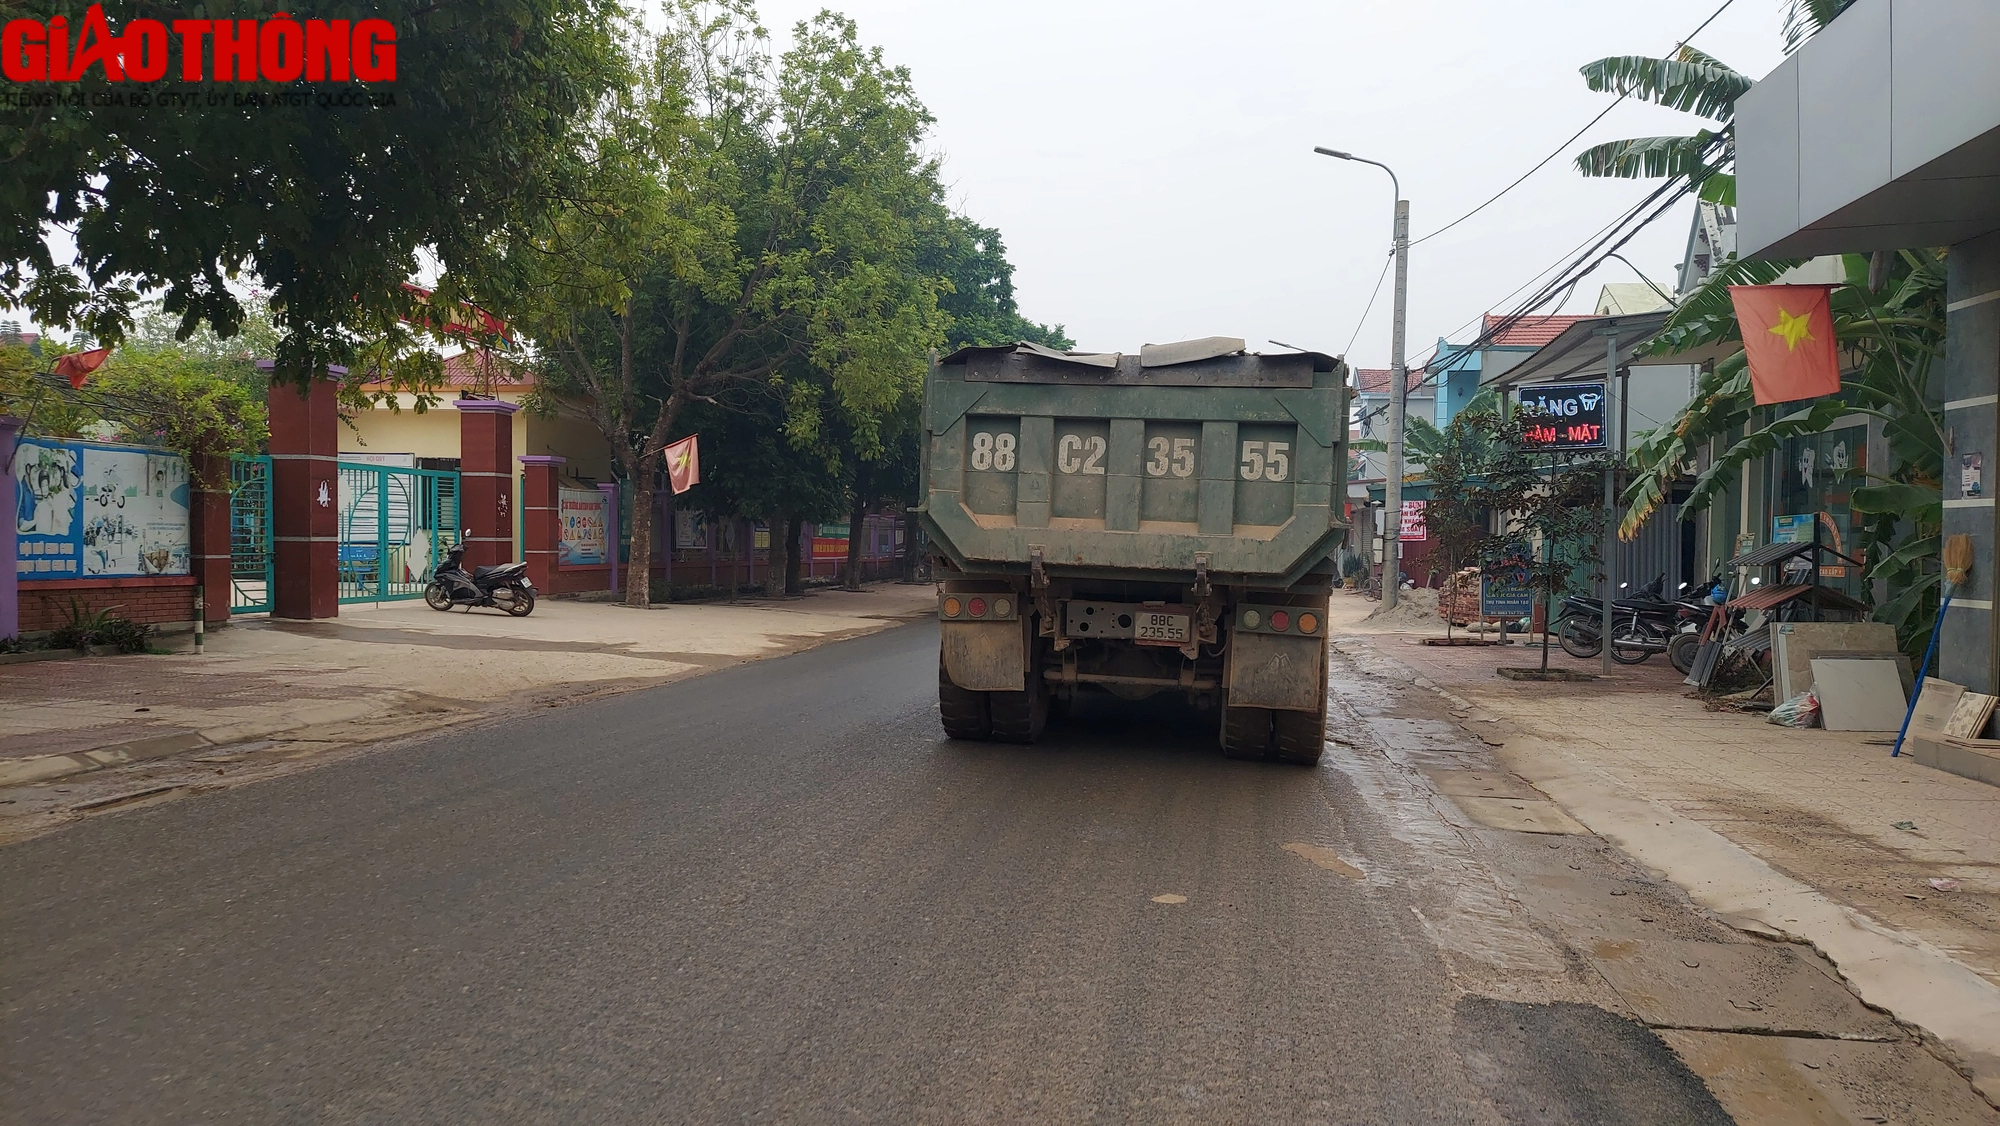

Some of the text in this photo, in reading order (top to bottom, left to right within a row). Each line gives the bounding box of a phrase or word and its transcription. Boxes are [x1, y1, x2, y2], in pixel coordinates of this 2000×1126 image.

[1567, 423, 1600, 443] MẶT
[971, 431, 1290, 482] 88 C2 35 55
[1150, 615, 1174, 627] 88C
[1140, 626, 1183, 639] 235.55
